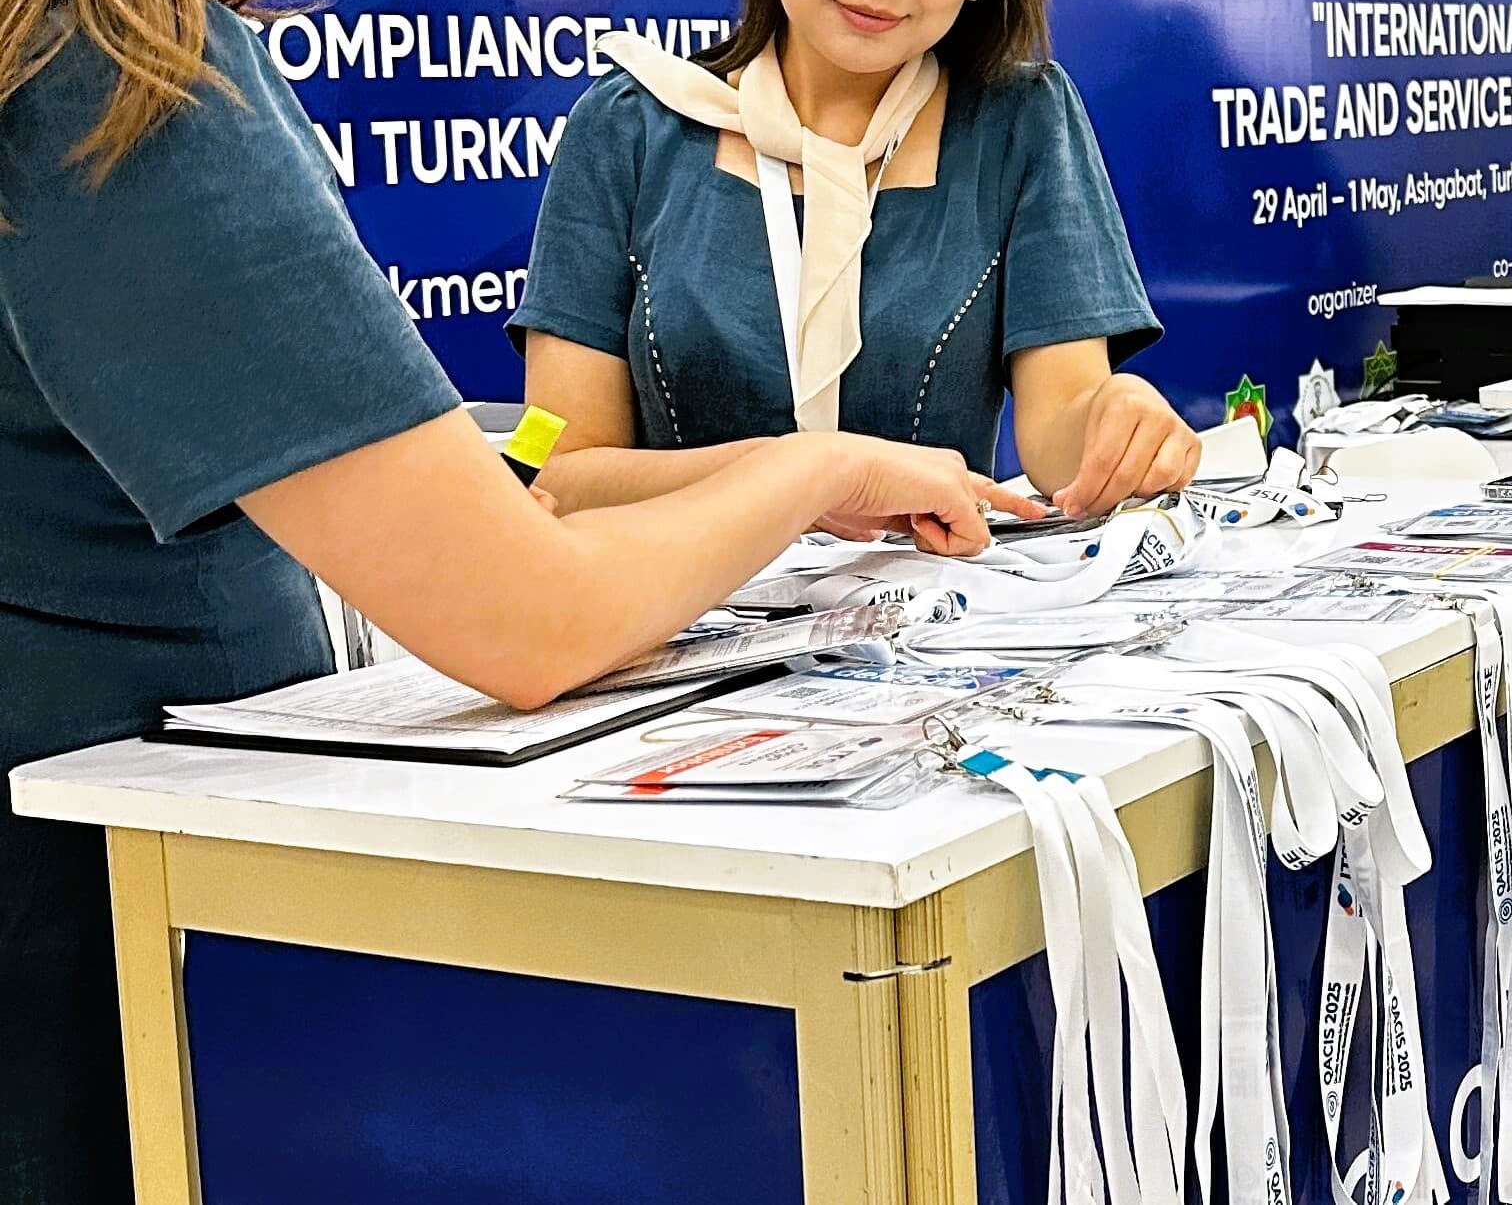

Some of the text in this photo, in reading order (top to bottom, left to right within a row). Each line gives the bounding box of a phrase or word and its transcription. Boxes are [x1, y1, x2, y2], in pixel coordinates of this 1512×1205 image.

[240, 13, 731, 81] OMPLIANCE WIT
[1212, 84, 1328, 149] TRADE
[1333, 81, 1400, 140] AND
[1252, 189, 1276, 225] 29
[1281, 182, 1328, 228] April
[1347, 185, 1358, 213] 1
[1360, 179, 1402, 216] May,
[1404, 169, 1488, 211] Ashgabat,
[1307, 281, 1378, 319] organizer
[1248, 488, 1289, 504] ITSE
[1483, 665, 1493, 711] ITSE
[1492, 809, 1507, 897] QACIS 2025
[1323, 981, 1343, 1086] QACIS 2025
[1391, 995, 1413, 1093] QACIS 2025
